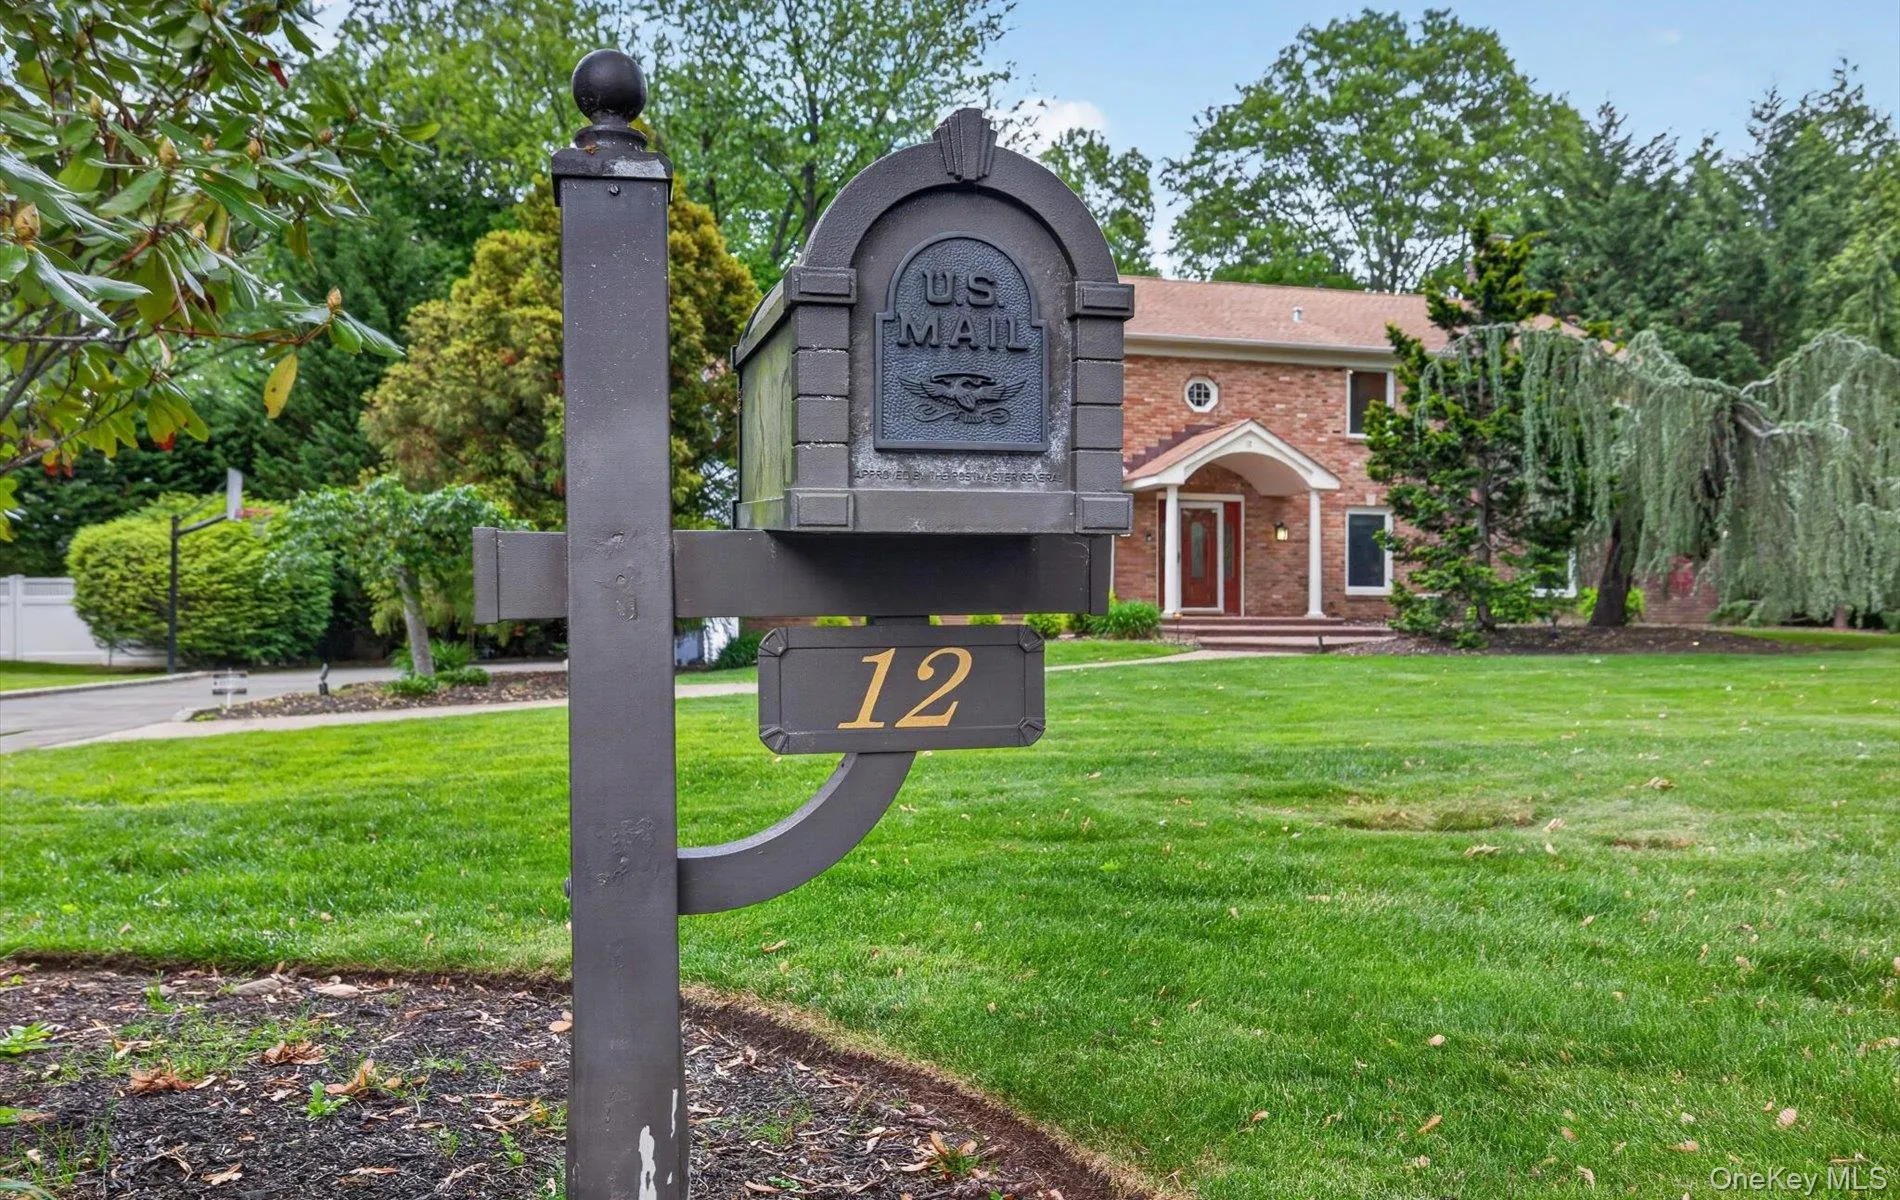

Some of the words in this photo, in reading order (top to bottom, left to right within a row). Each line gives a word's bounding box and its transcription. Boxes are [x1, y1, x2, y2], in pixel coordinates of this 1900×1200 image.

[922, 270, 1006, 308] U.S.
[897, 313, 1030, 351] MAIL
[952, 471, 1018, 482] POSTMASTER
[1020, 472, 1064, 483] GENERAL
[837, 647, 973, 729] 12
